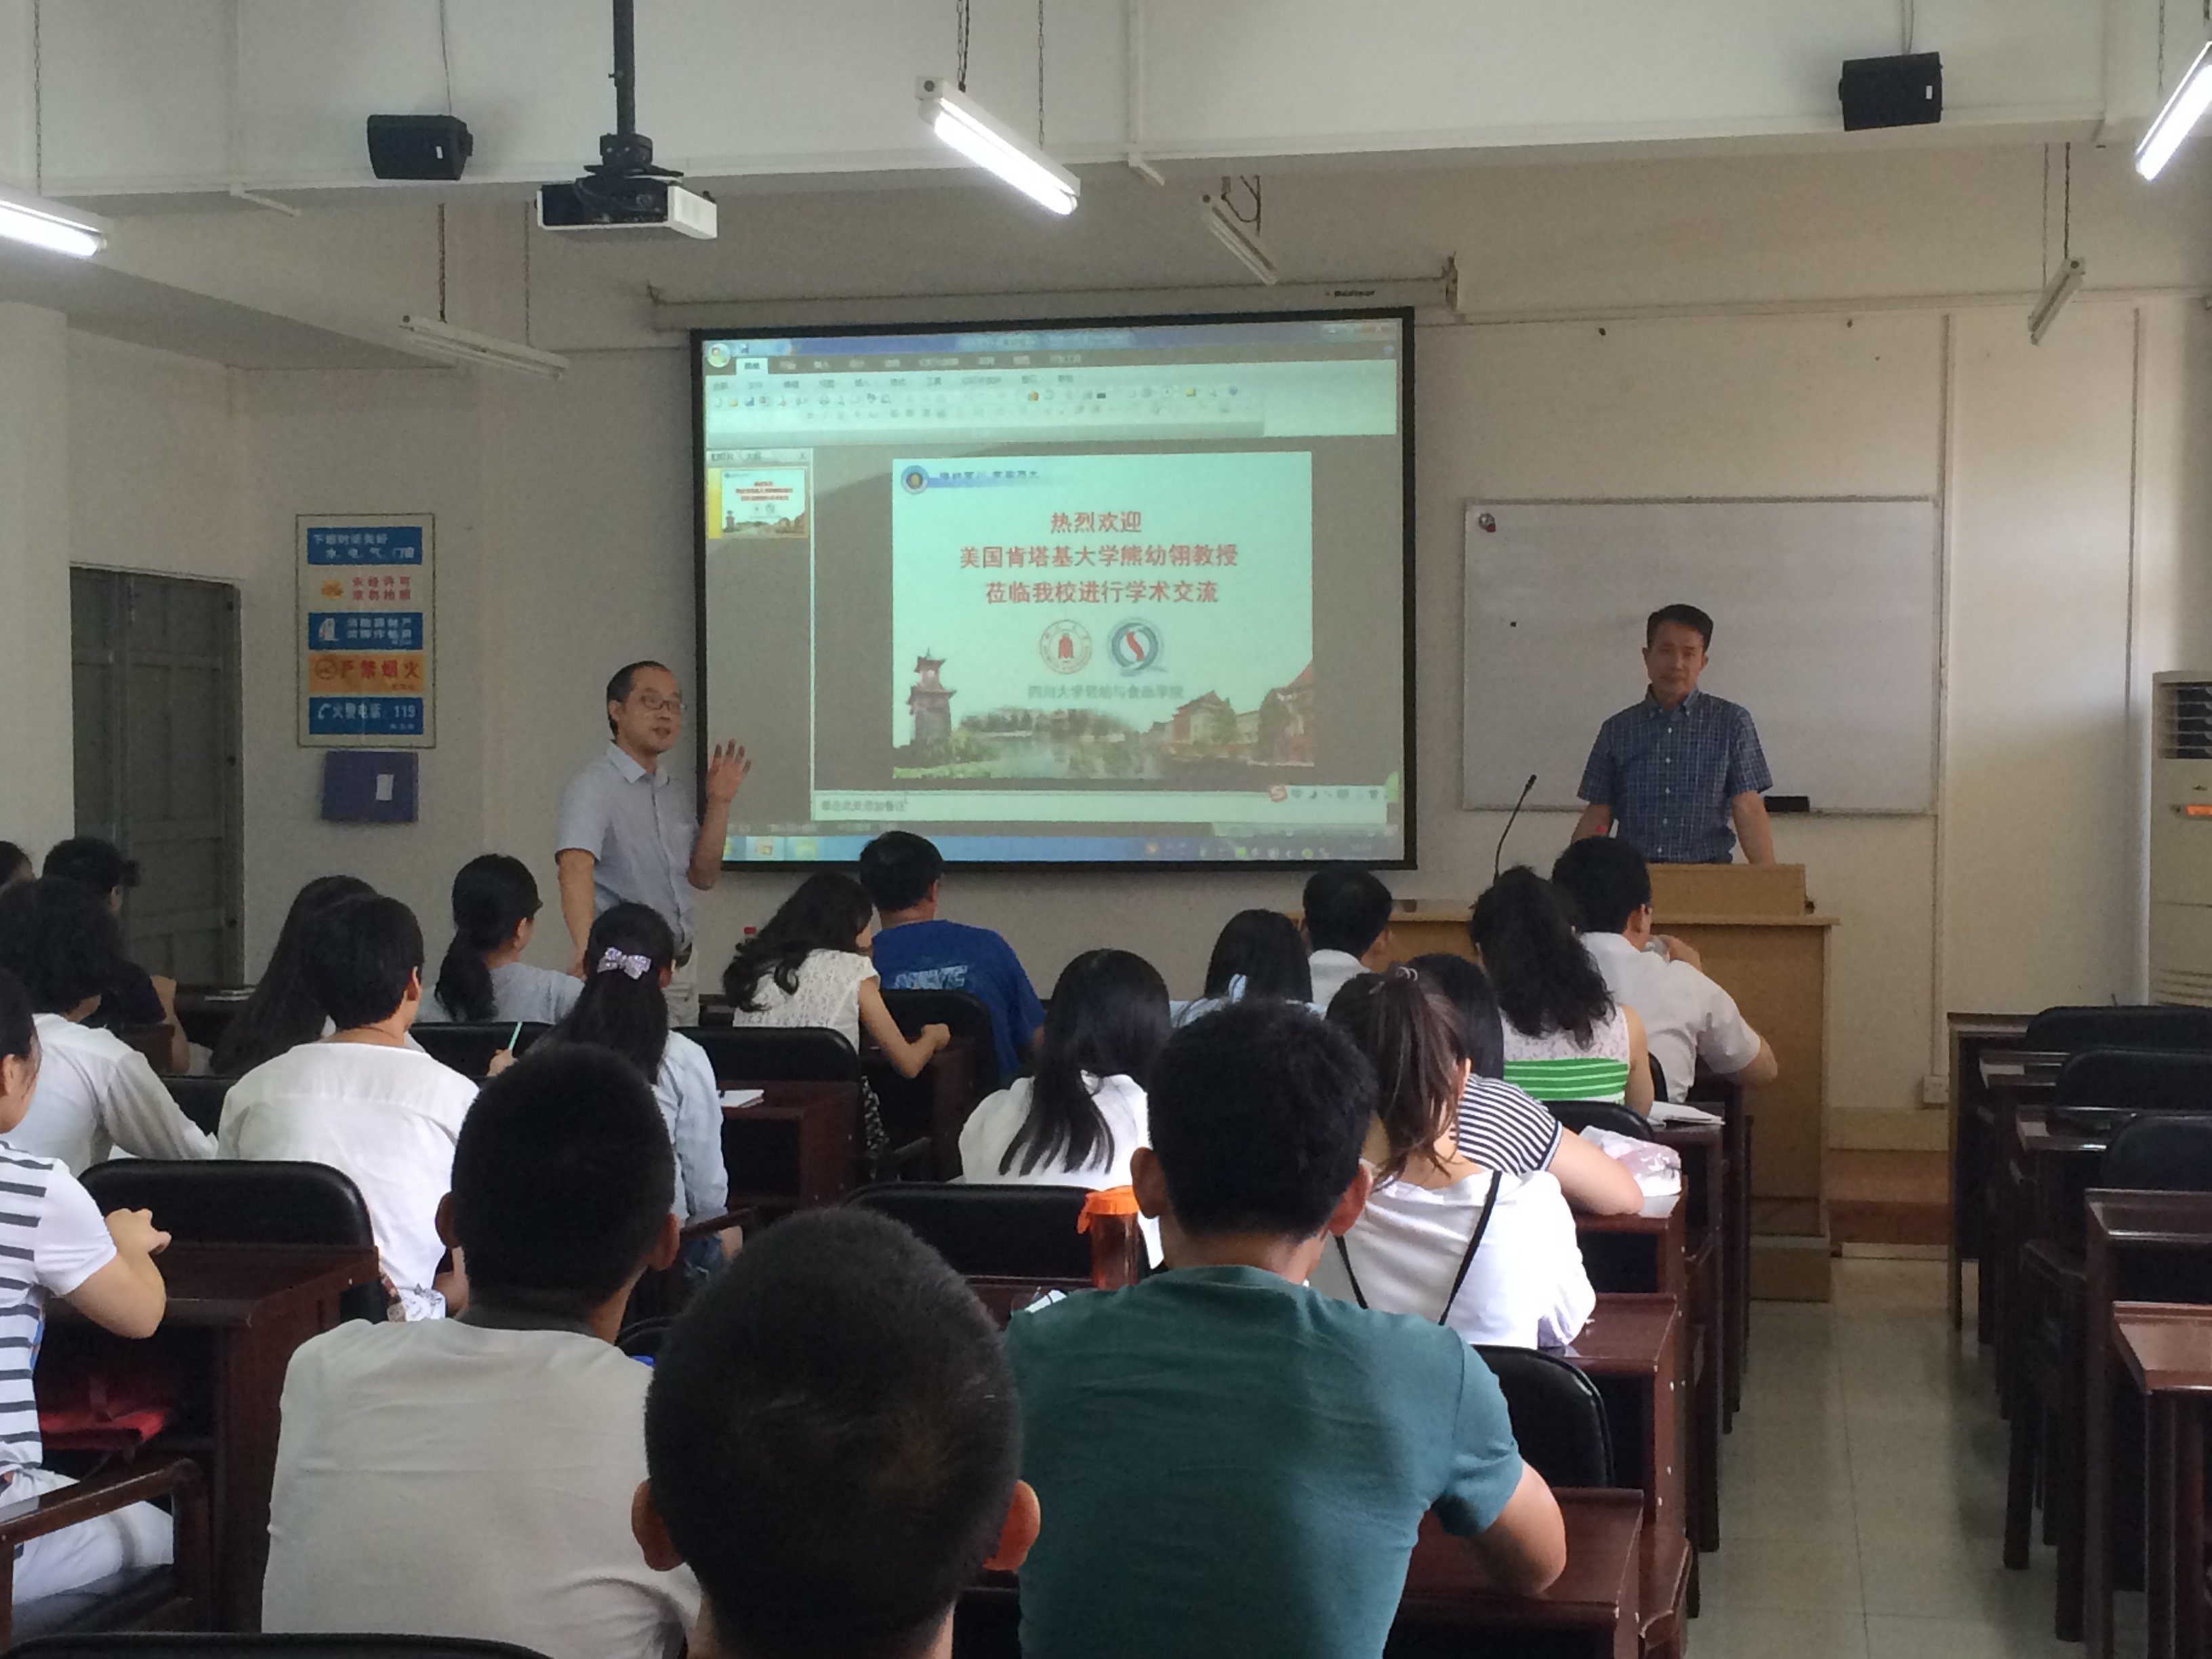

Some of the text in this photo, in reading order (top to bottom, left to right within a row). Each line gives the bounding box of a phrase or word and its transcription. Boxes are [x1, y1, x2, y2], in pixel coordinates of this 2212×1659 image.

[1051, 510, 1143, 534] 热烈欢迎
[960, 544, 1239, 569] 美国肯塔基大学熊幼翎教授
[985, 580, 1218, 604] 莅临我校进行学术交流
[340, 659, 420, 679] 严禁烟火
[394, 704, 416, 718] 119
